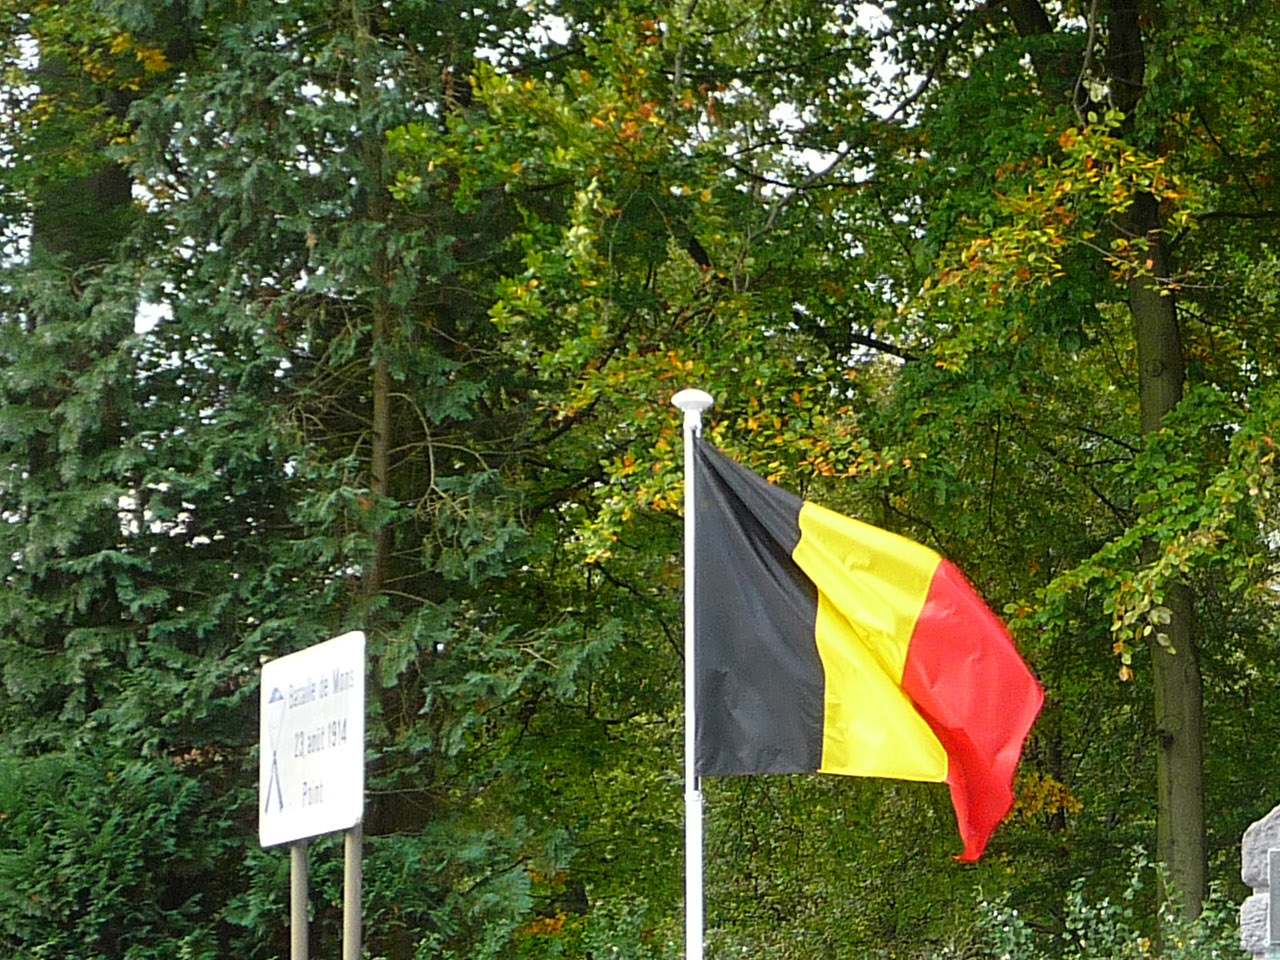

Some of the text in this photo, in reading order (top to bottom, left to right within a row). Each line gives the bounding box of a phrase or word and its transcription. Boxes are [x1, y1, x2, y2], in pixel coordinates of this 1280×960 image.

[319, 672, 328, 699] de
[294, 730, 305, 759] 23
[328, 717, 347, 749] 1914
